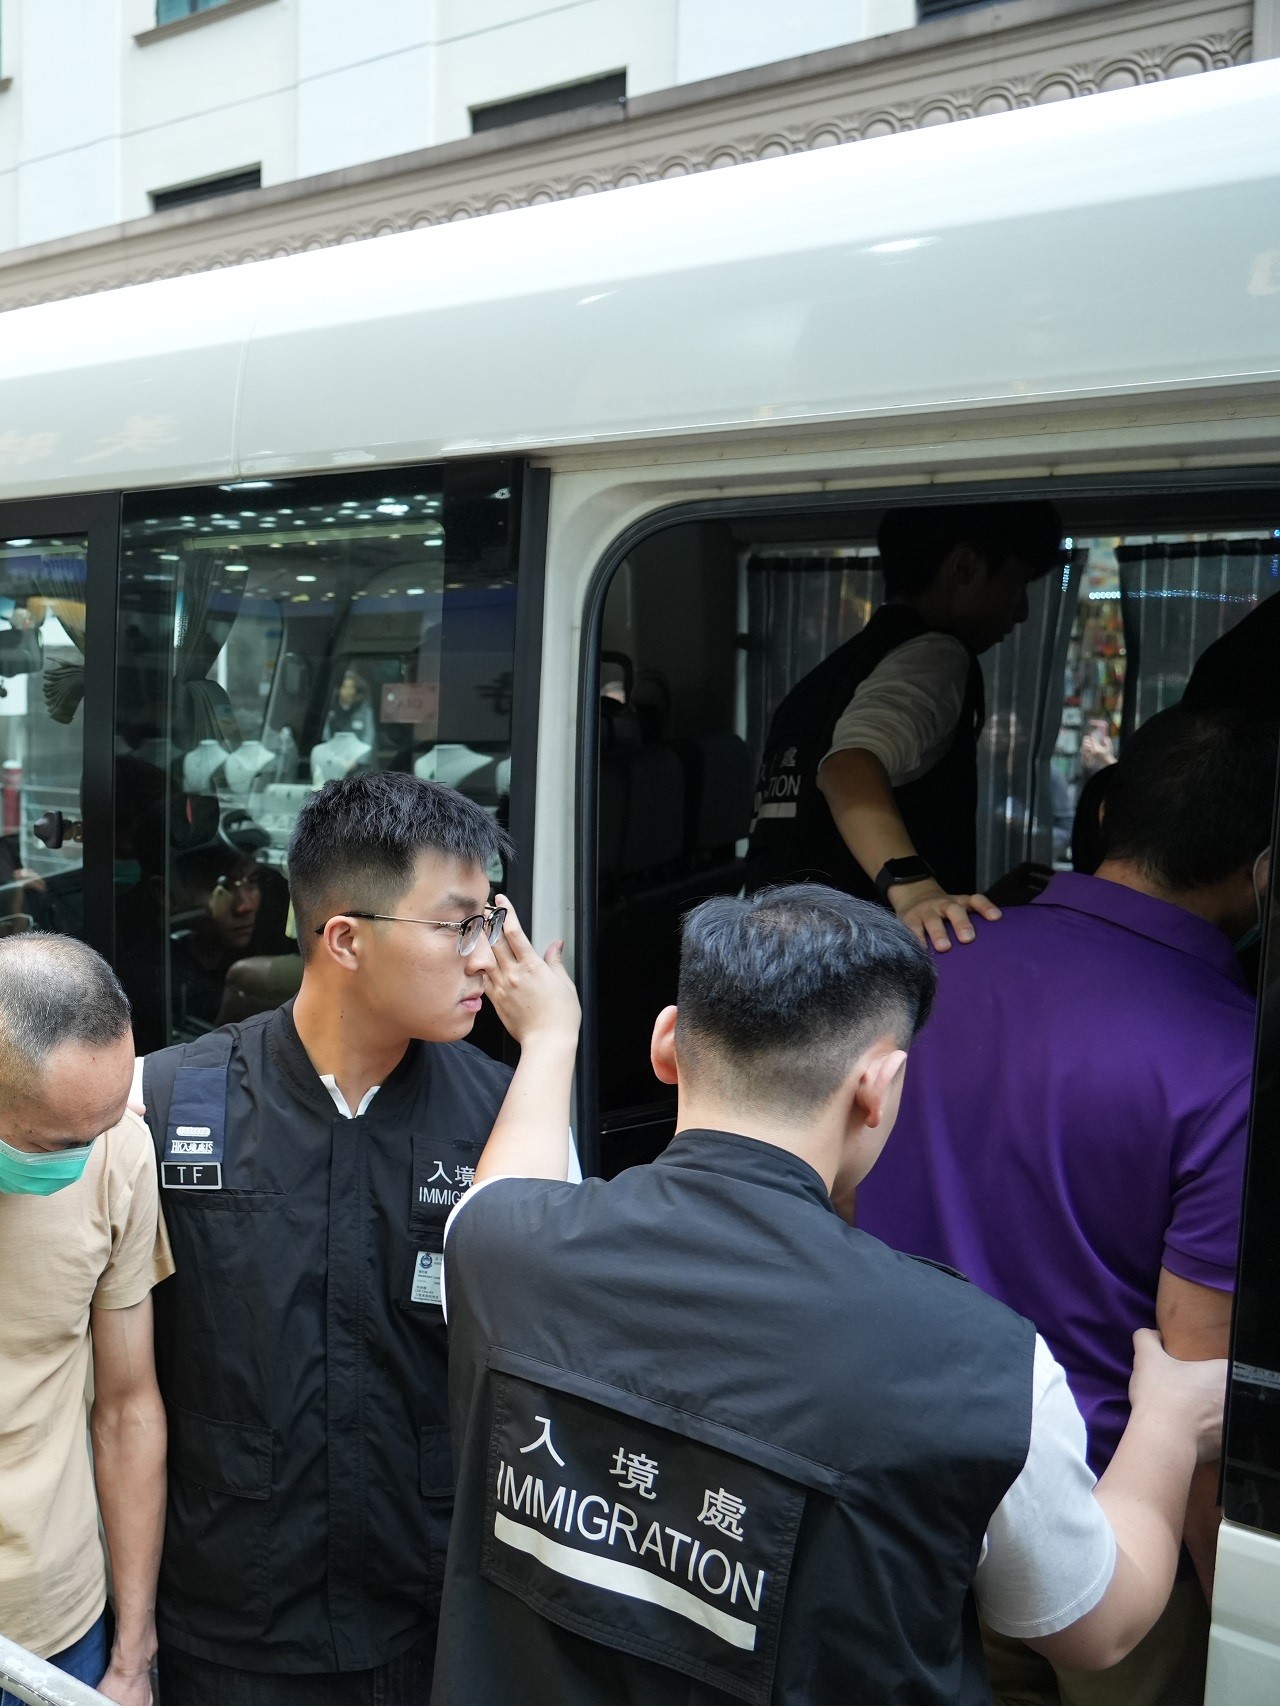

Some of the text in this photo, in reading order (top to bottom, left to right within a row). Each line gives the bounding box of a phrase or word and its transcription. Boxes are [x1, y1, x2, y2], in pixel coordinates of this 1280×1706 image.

[419, 1186, 465, 1206] IMMIG
[496, 1460, 765, 1612] IMMIGRATION
[519, 1414, 747, 1543] 入境處
